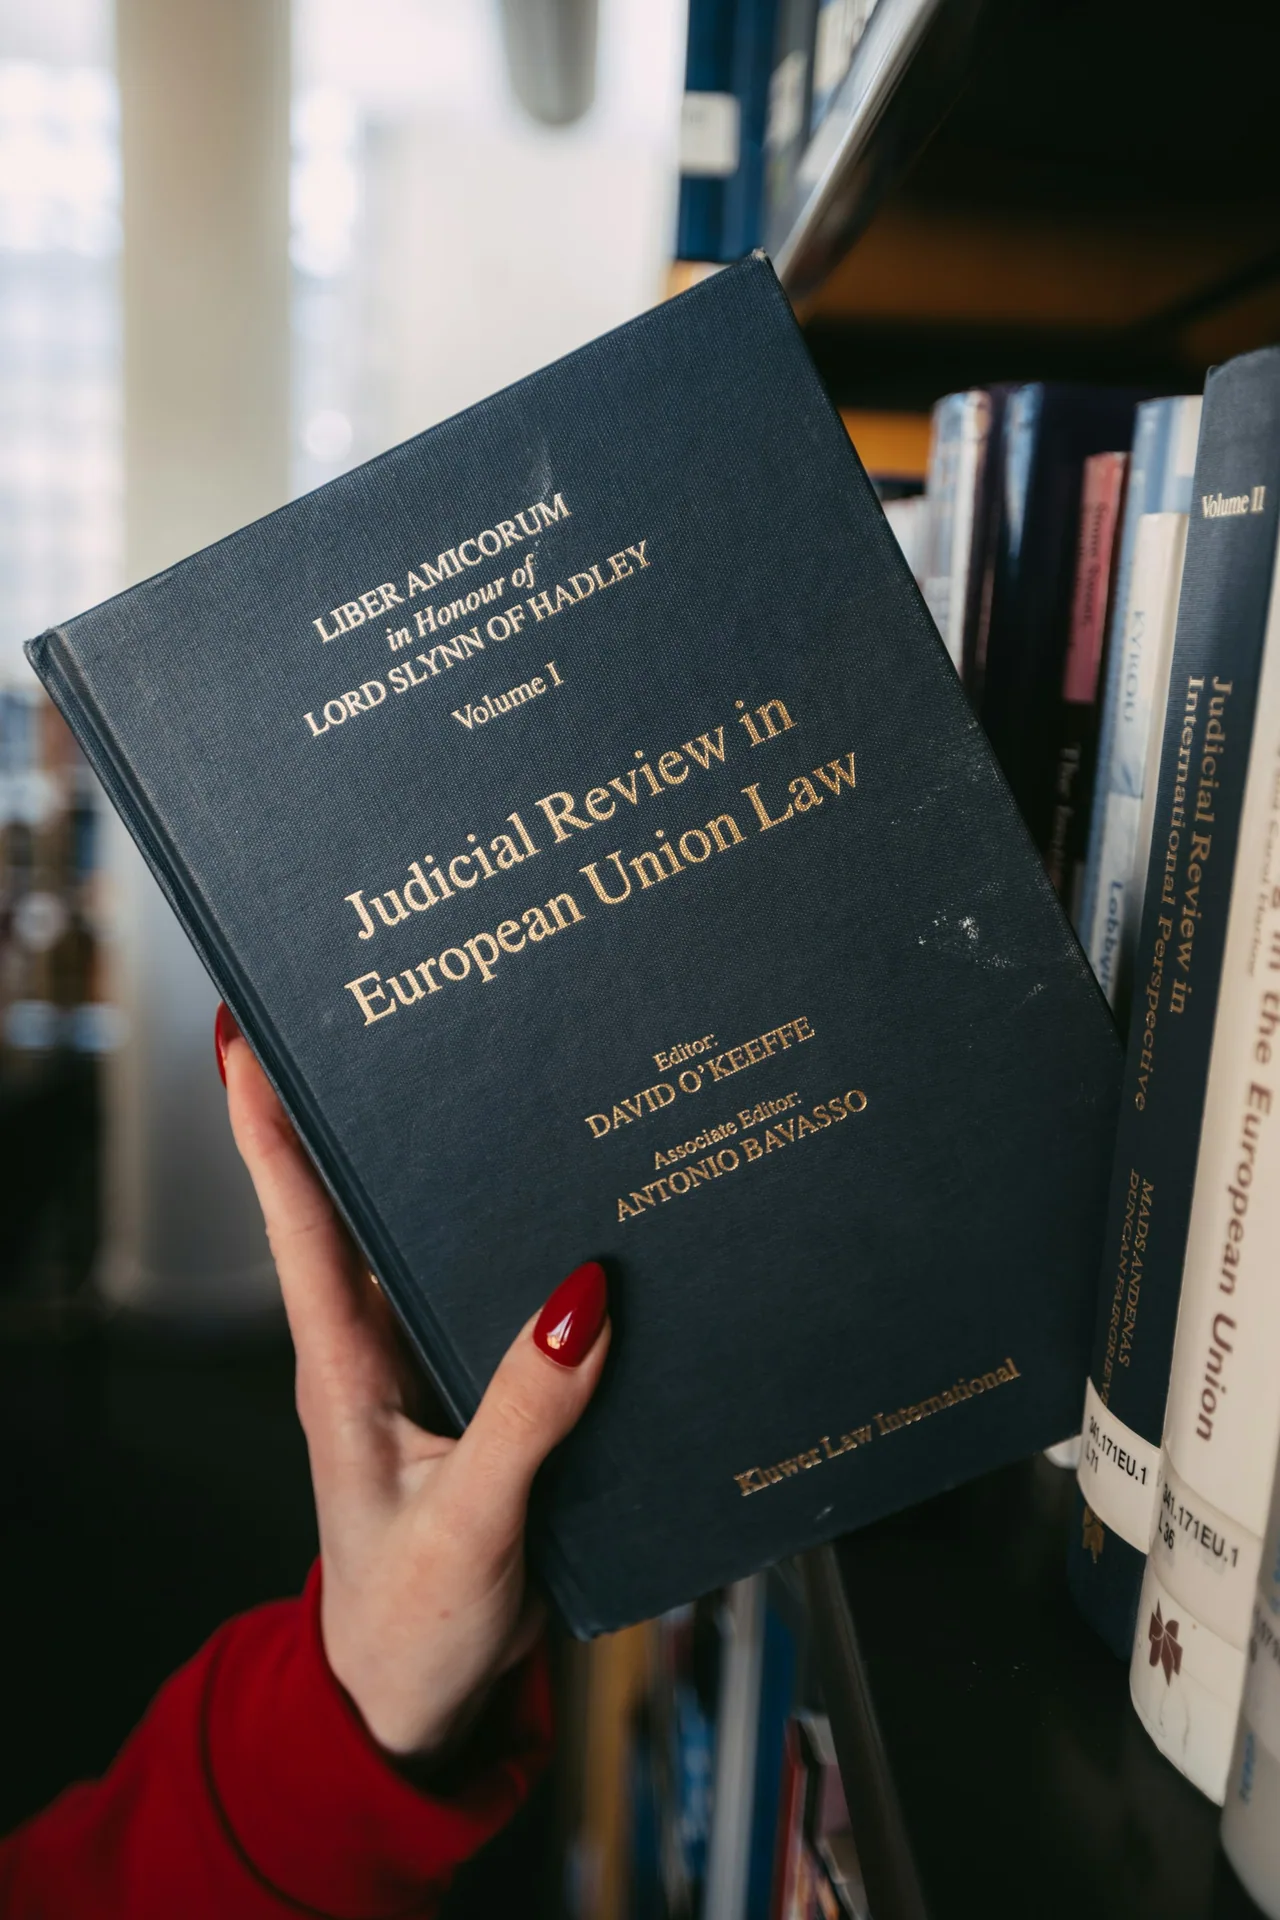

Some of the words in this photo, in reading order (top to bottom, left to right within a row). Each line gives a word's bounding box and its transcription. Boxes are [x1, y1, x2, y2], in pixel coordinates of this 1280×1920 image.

[1202, 492, 1249, 518] Volume
[1250, 485, 1266, 511] II
[312, 581, 405, 643] LIBER
[406, 492, 573, 598] AMICORUM
[386, 625, 413, 651] in
[413, 575, 505, 637] Honour
[511, 553, 537, 588] of
[303, 680, 388, 737] LORD
[388, 627, 486, 694] SLYNN
[486, 604, 528, 642] OF
[526, 540, 652, 622] HADLEY
[452, 669, 547, 730] Volume
[544, 660, 565, 688] I
[1160, 675, 1206, 906] International
[1194, 675, 1234, 824] Judicial
[344, 811, 542, 940] Judicial
[534, 725, 726, 844] Review
[735, 698, 798, 748] in
[344, 892, 587, 1028] European
[578, 812, 747, 905] Union
[740, 751, 858, 832] Law
[1176, 830, 1213, 973] Review
[652, 1033, 719, 1072] Editor:
[1135, 912, 1174, 1111] Perspective
[1169, 977, 1193, 1014] in
[1255, 990, 1280, 1066] the
[585, 1083, 676, 1138] DAVID
[678, 1016, 816, 1093] O'KEEFFE
[653, 1121, 738, 1170] Associate
[736, 1091, 802, 1129] Editor:
[617, 1148, 740, 1222] ANTONIO
[739, 1089, 868, 1163] BAVASSO
[1134, 1178, 1154, 1252] MADS
[1219, 1080, 1274, 1296] European
[1118, 1168, 1140, 1276] DUNCAN
[1118, 1250, 1144, 1368] ANDENAS
[732, 1447, 823, 1497] Kluwer
[819, 1424, 873, 1459] Law
[872, 1356, 1022, 1436] International
[1196, 1312, 1238, 1442] Union
